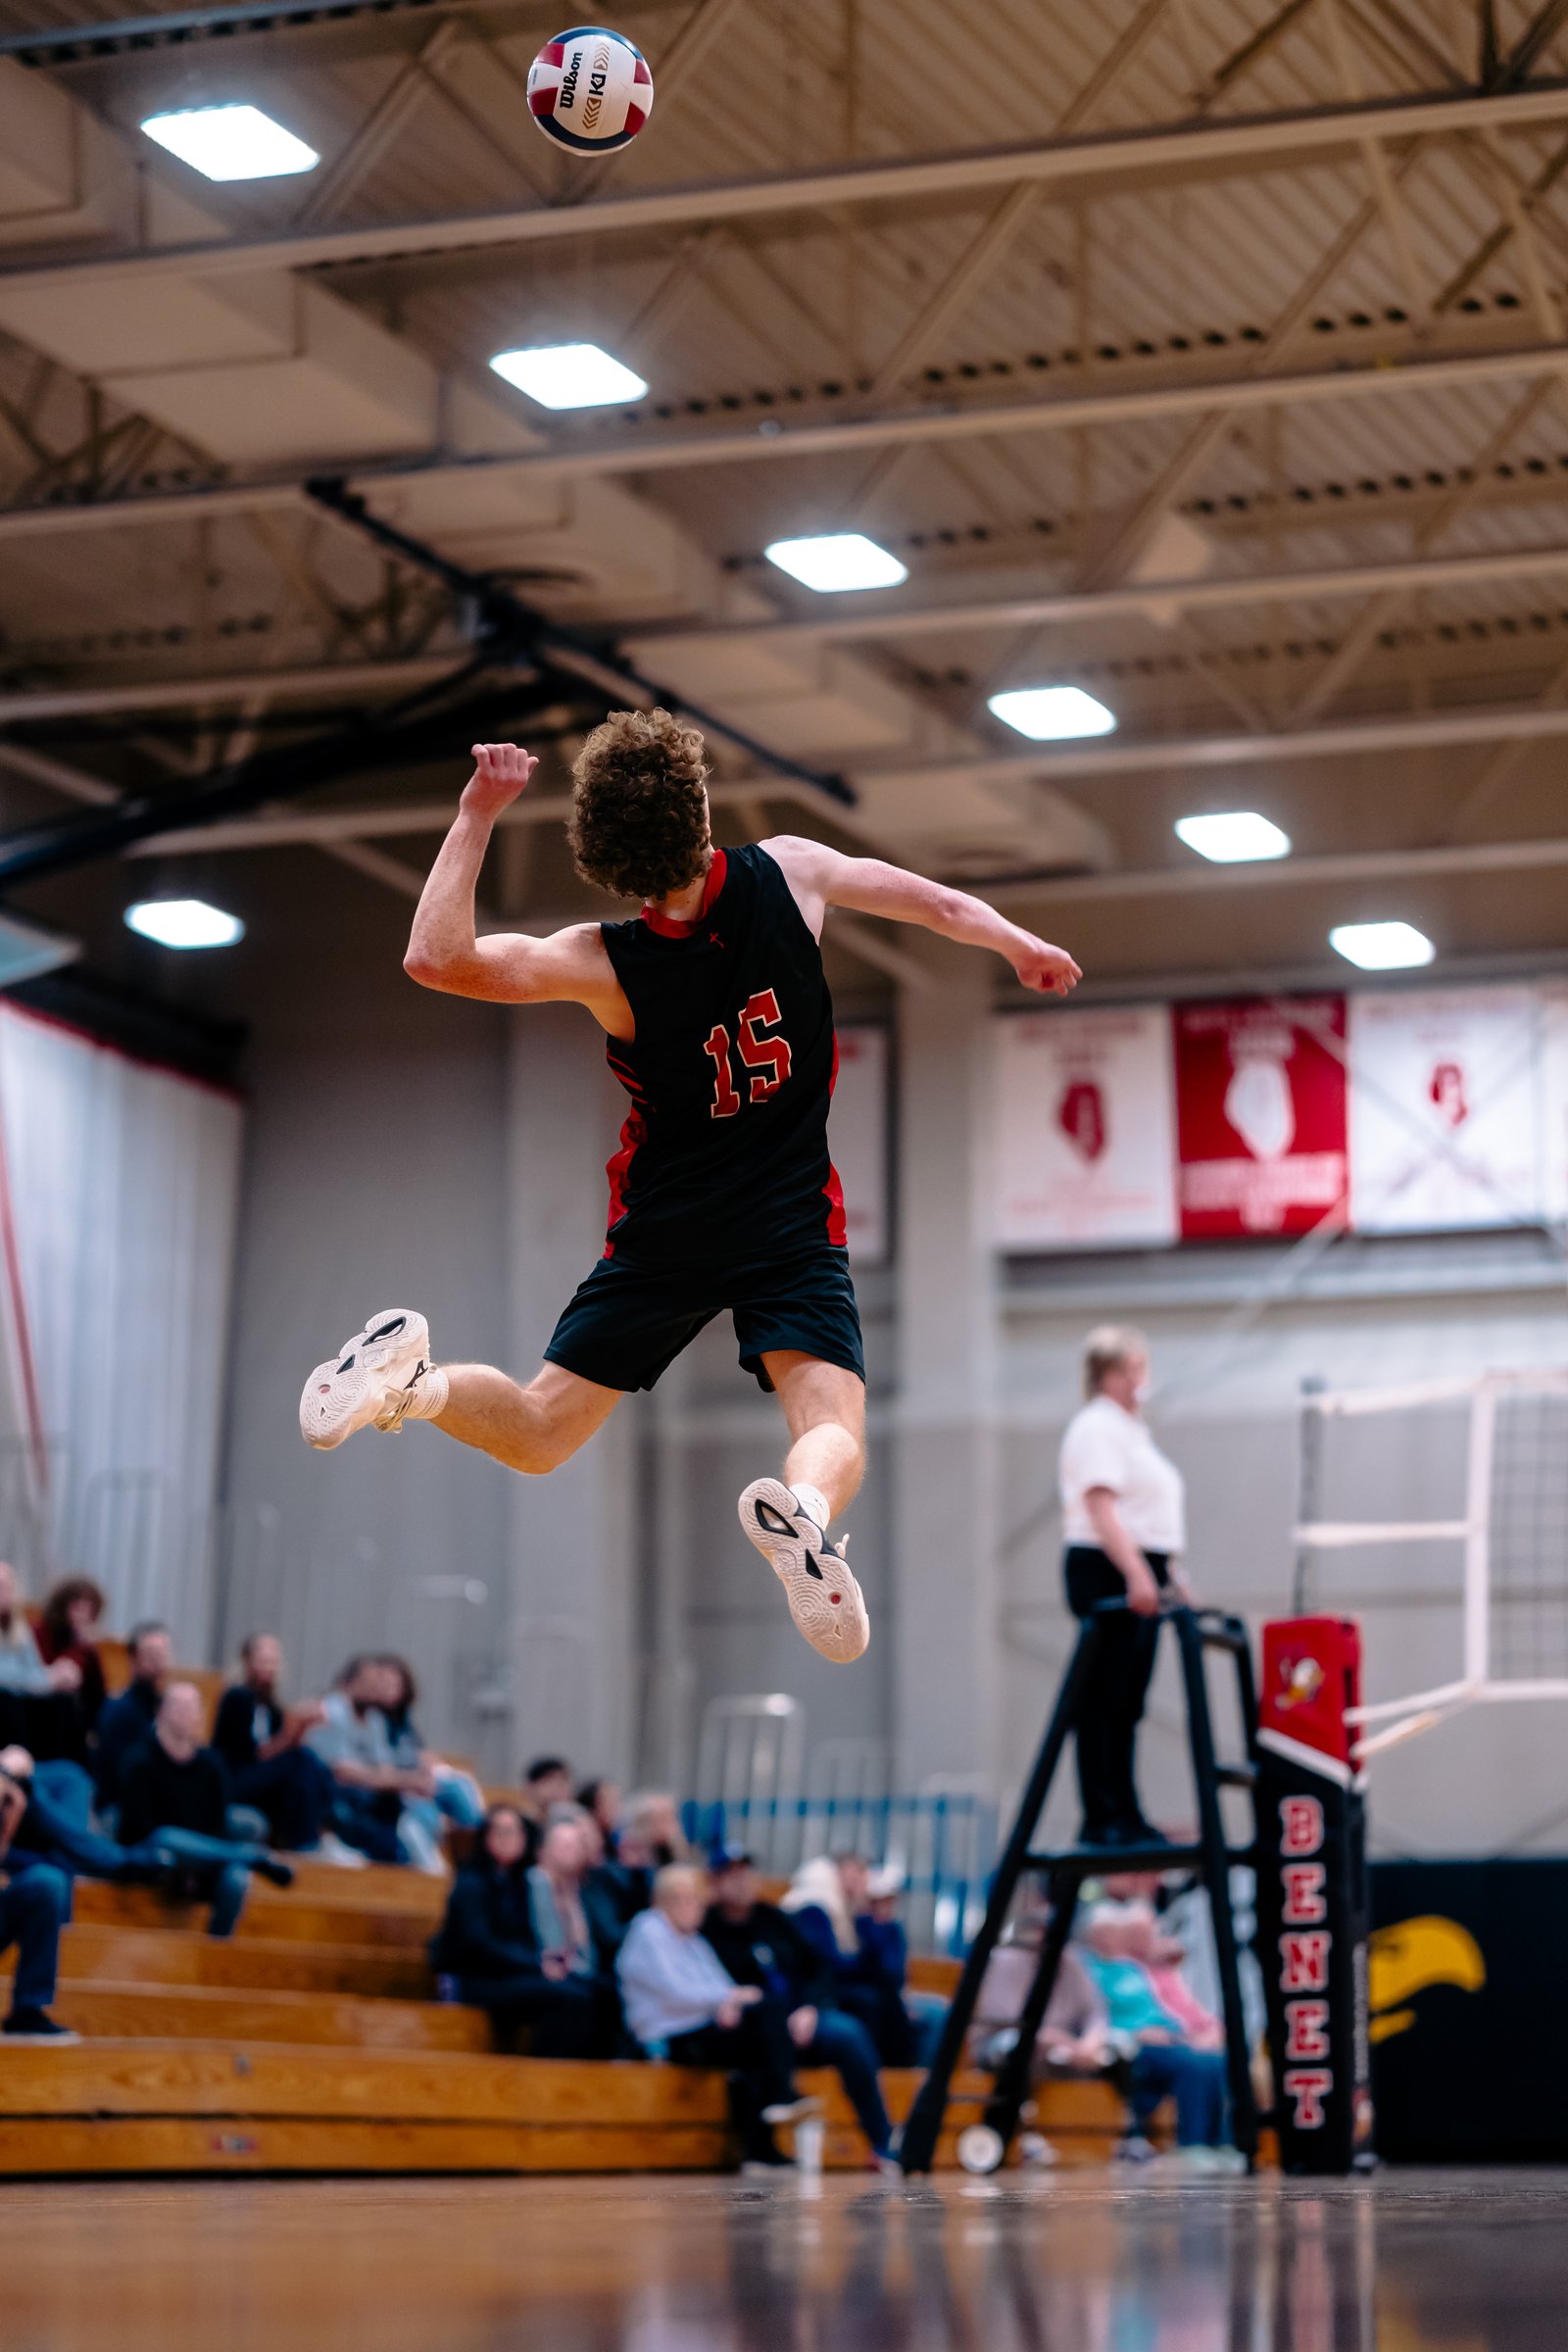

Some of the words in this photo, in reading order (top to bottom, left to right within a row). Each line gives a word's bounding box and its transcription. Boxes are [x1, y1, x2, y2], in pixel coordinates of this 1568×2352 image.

[560, 52, 583, 109] Wilson
[703, 988, 792, 1118] 15
[1279, 1794, 1333, 2129] BENET
